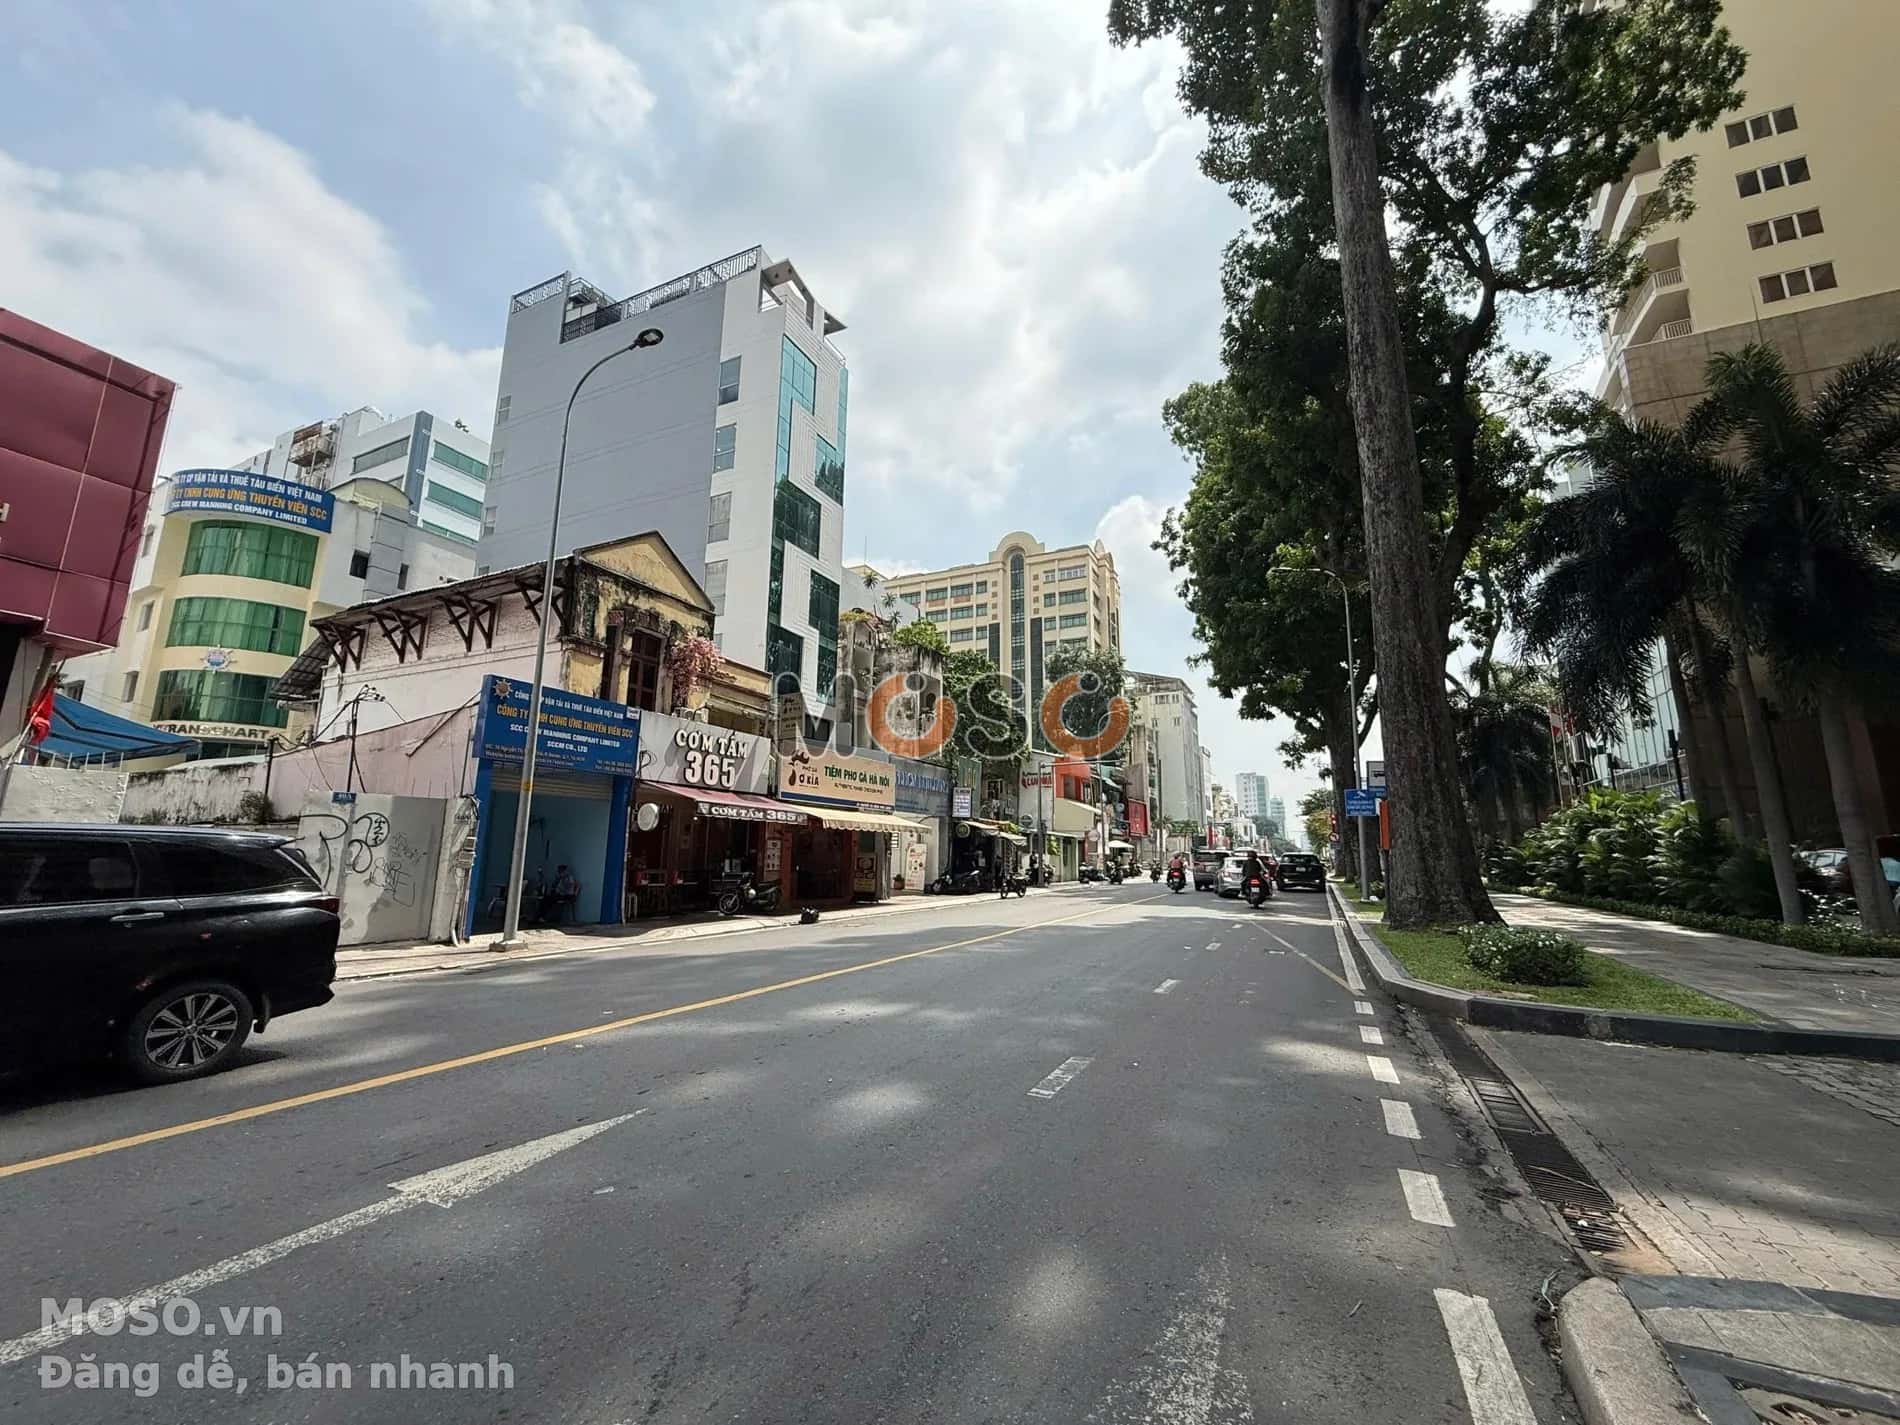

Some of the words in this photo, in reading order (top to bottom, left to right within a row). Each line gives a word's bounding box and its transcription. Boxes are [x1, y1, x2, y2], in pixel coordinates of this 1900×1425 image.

[203, 488, 226, 498] CUNG
[310, 506, 327, 520] SCC
[288, 486, 303, 498] VIỆT
[305, 490, 322, 503] NAM
[234, 503, 273, 517] COMPANY
[275, 511, 308, 524] LIMITED
[497, 704, 518, 717] CÔNG
[520, 708, 528, 719] TY
[549, 714, 568, 726] CUNG
[622, 728, 633, 738] SCC
[510, 724, 523, 732] SCC
[572, 734, 600, 744] COMPANY
[675, 729, 713, 752] CƠM
[718, 734, 748, 758] TẤM
[685, 751, 736, 788] 365
[824, 765, 842, 780] TIỆM
[711, 806, 737, 816] CƠM
[740, 808, 764, 818] TẤM
[766, 810, 797, 821] 365
